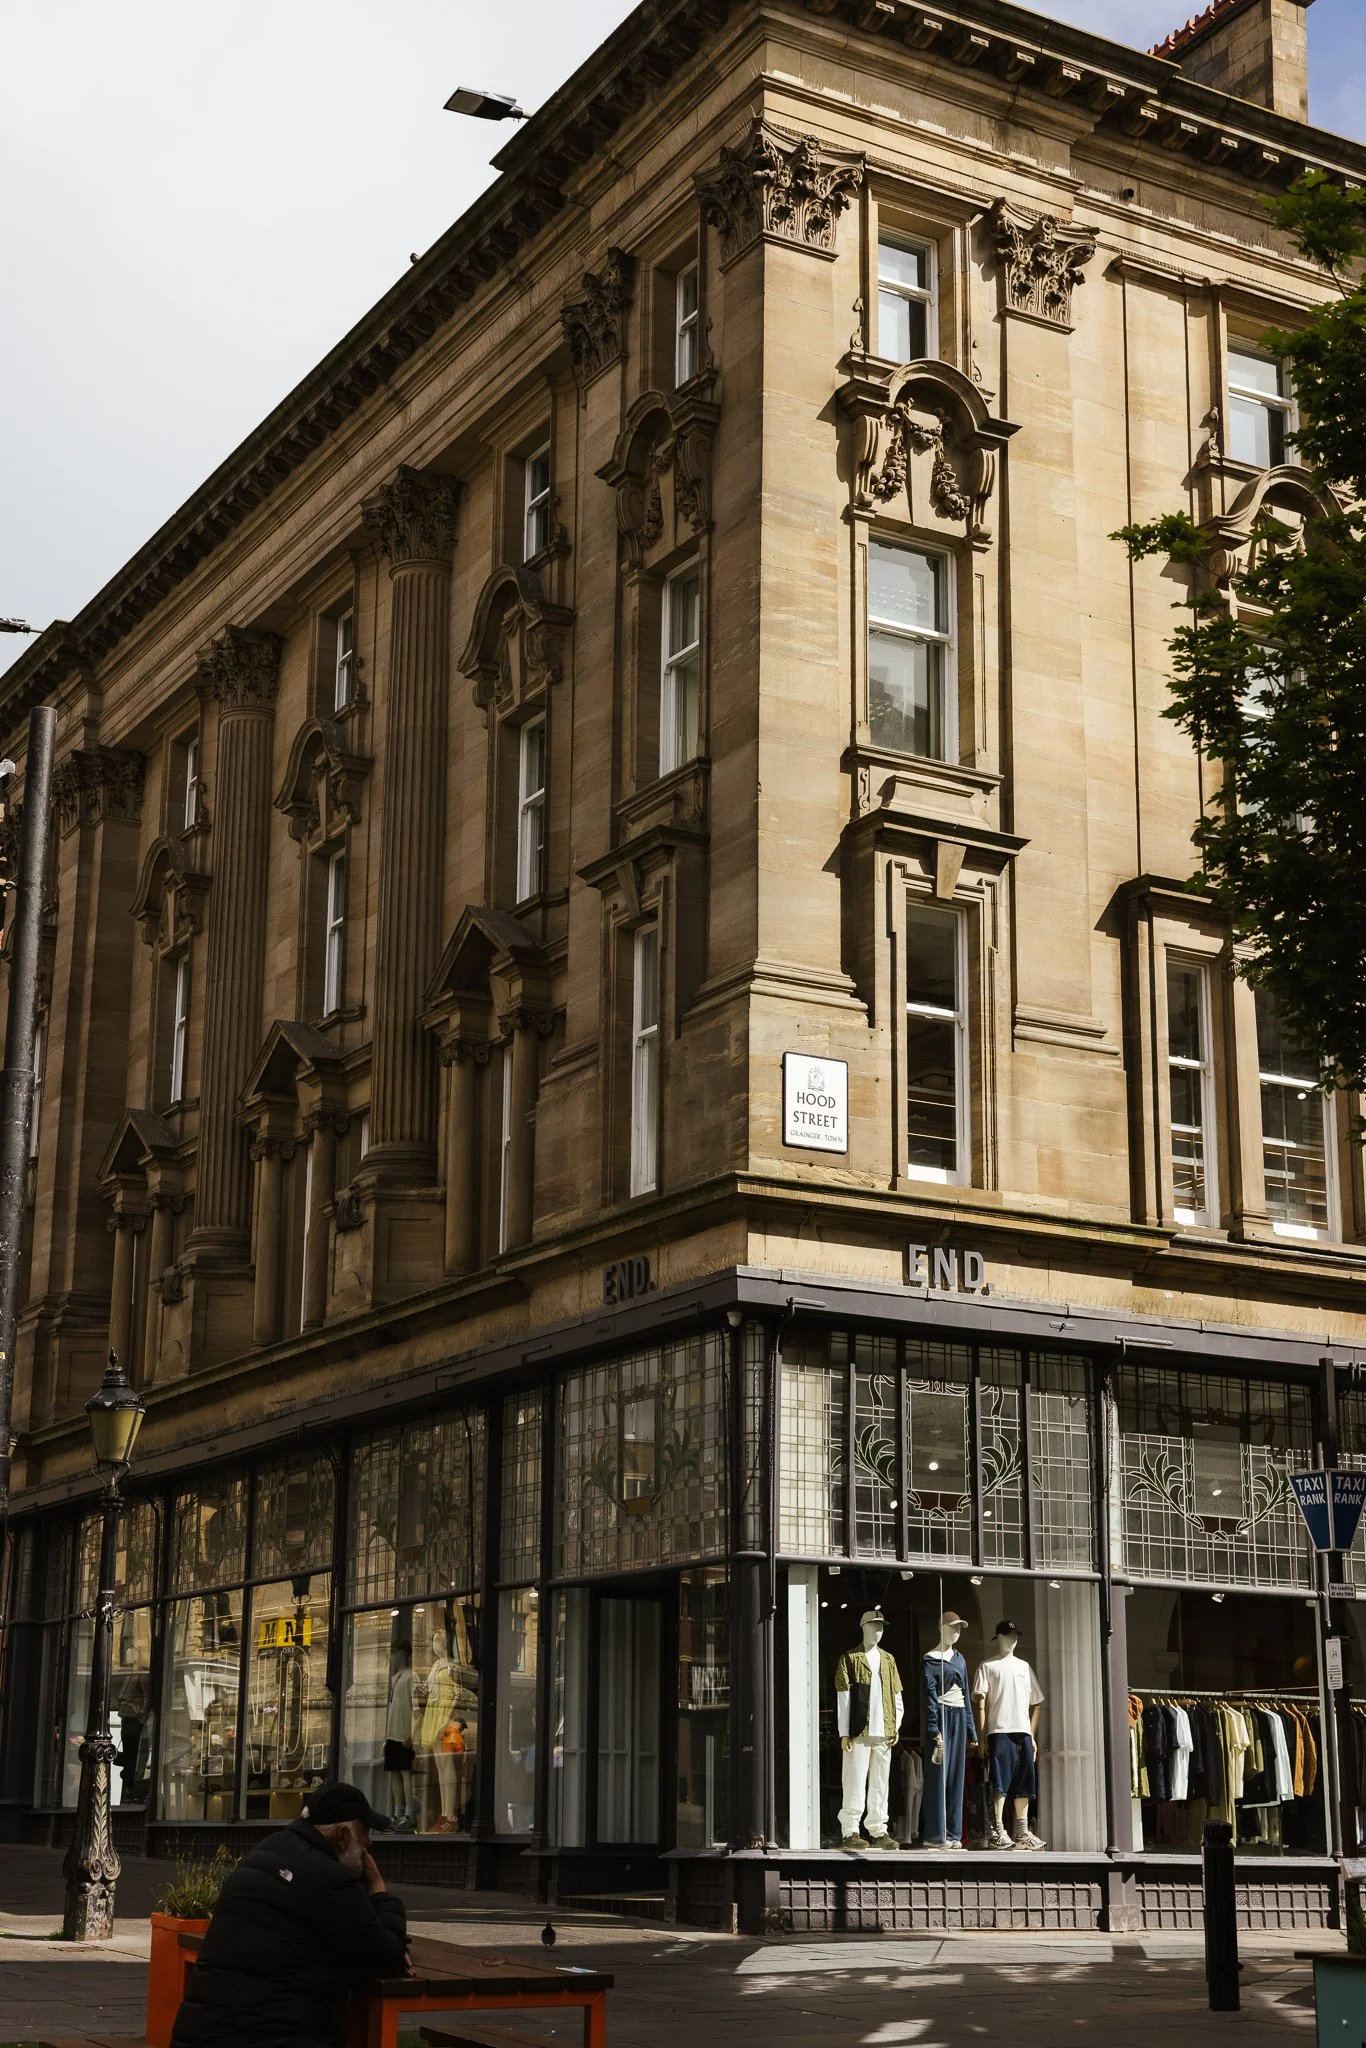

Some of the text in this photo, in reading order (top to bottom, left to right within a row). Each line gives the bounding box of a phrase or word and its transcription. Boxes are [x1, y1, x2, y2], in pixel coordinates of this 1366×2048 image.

[796, 1091, 836, 1109] HOOD
[793, 1110, 838, 1129] STREET
[790, 1129, 843, 1143] GRAINGER TOWN
[1295, 1475, 1324, 1492] TAXI
[1336, 1476, 1366, 1491] TAXI
[1299, 1493, 1327, 1506] RANK
[1334, 1492, 1363, 1505] RANK
[1337, 1584, 1354, 1592] loading
